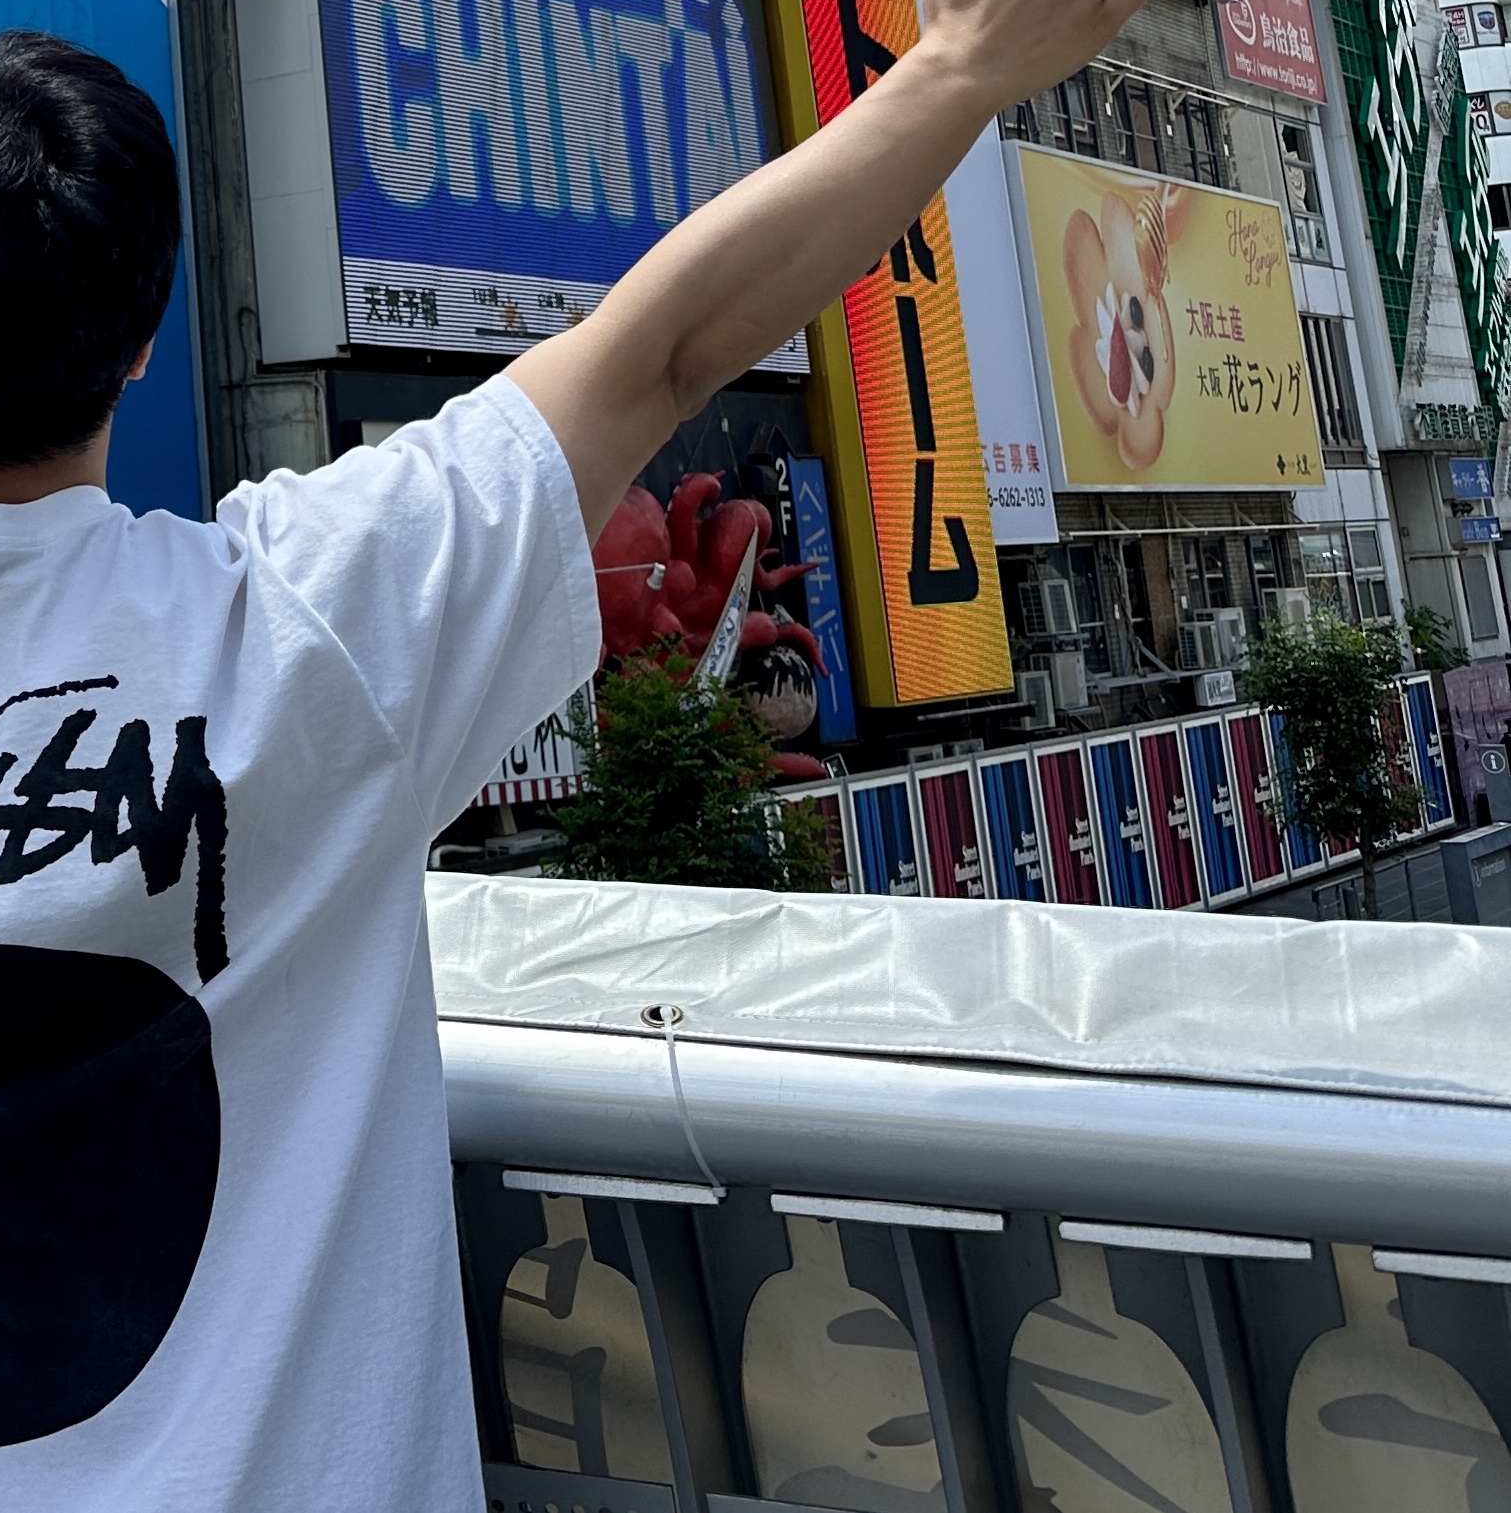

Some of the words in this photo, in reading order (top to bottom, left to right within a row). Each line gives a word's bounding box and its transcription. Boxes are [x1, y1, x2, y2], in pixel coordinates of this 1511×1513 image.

[1186, 298, 1245, 342] 大阪土産
[1196, 365, 1223, 398] 大阪
[1223, 354, 1301, 416] 花ラング
